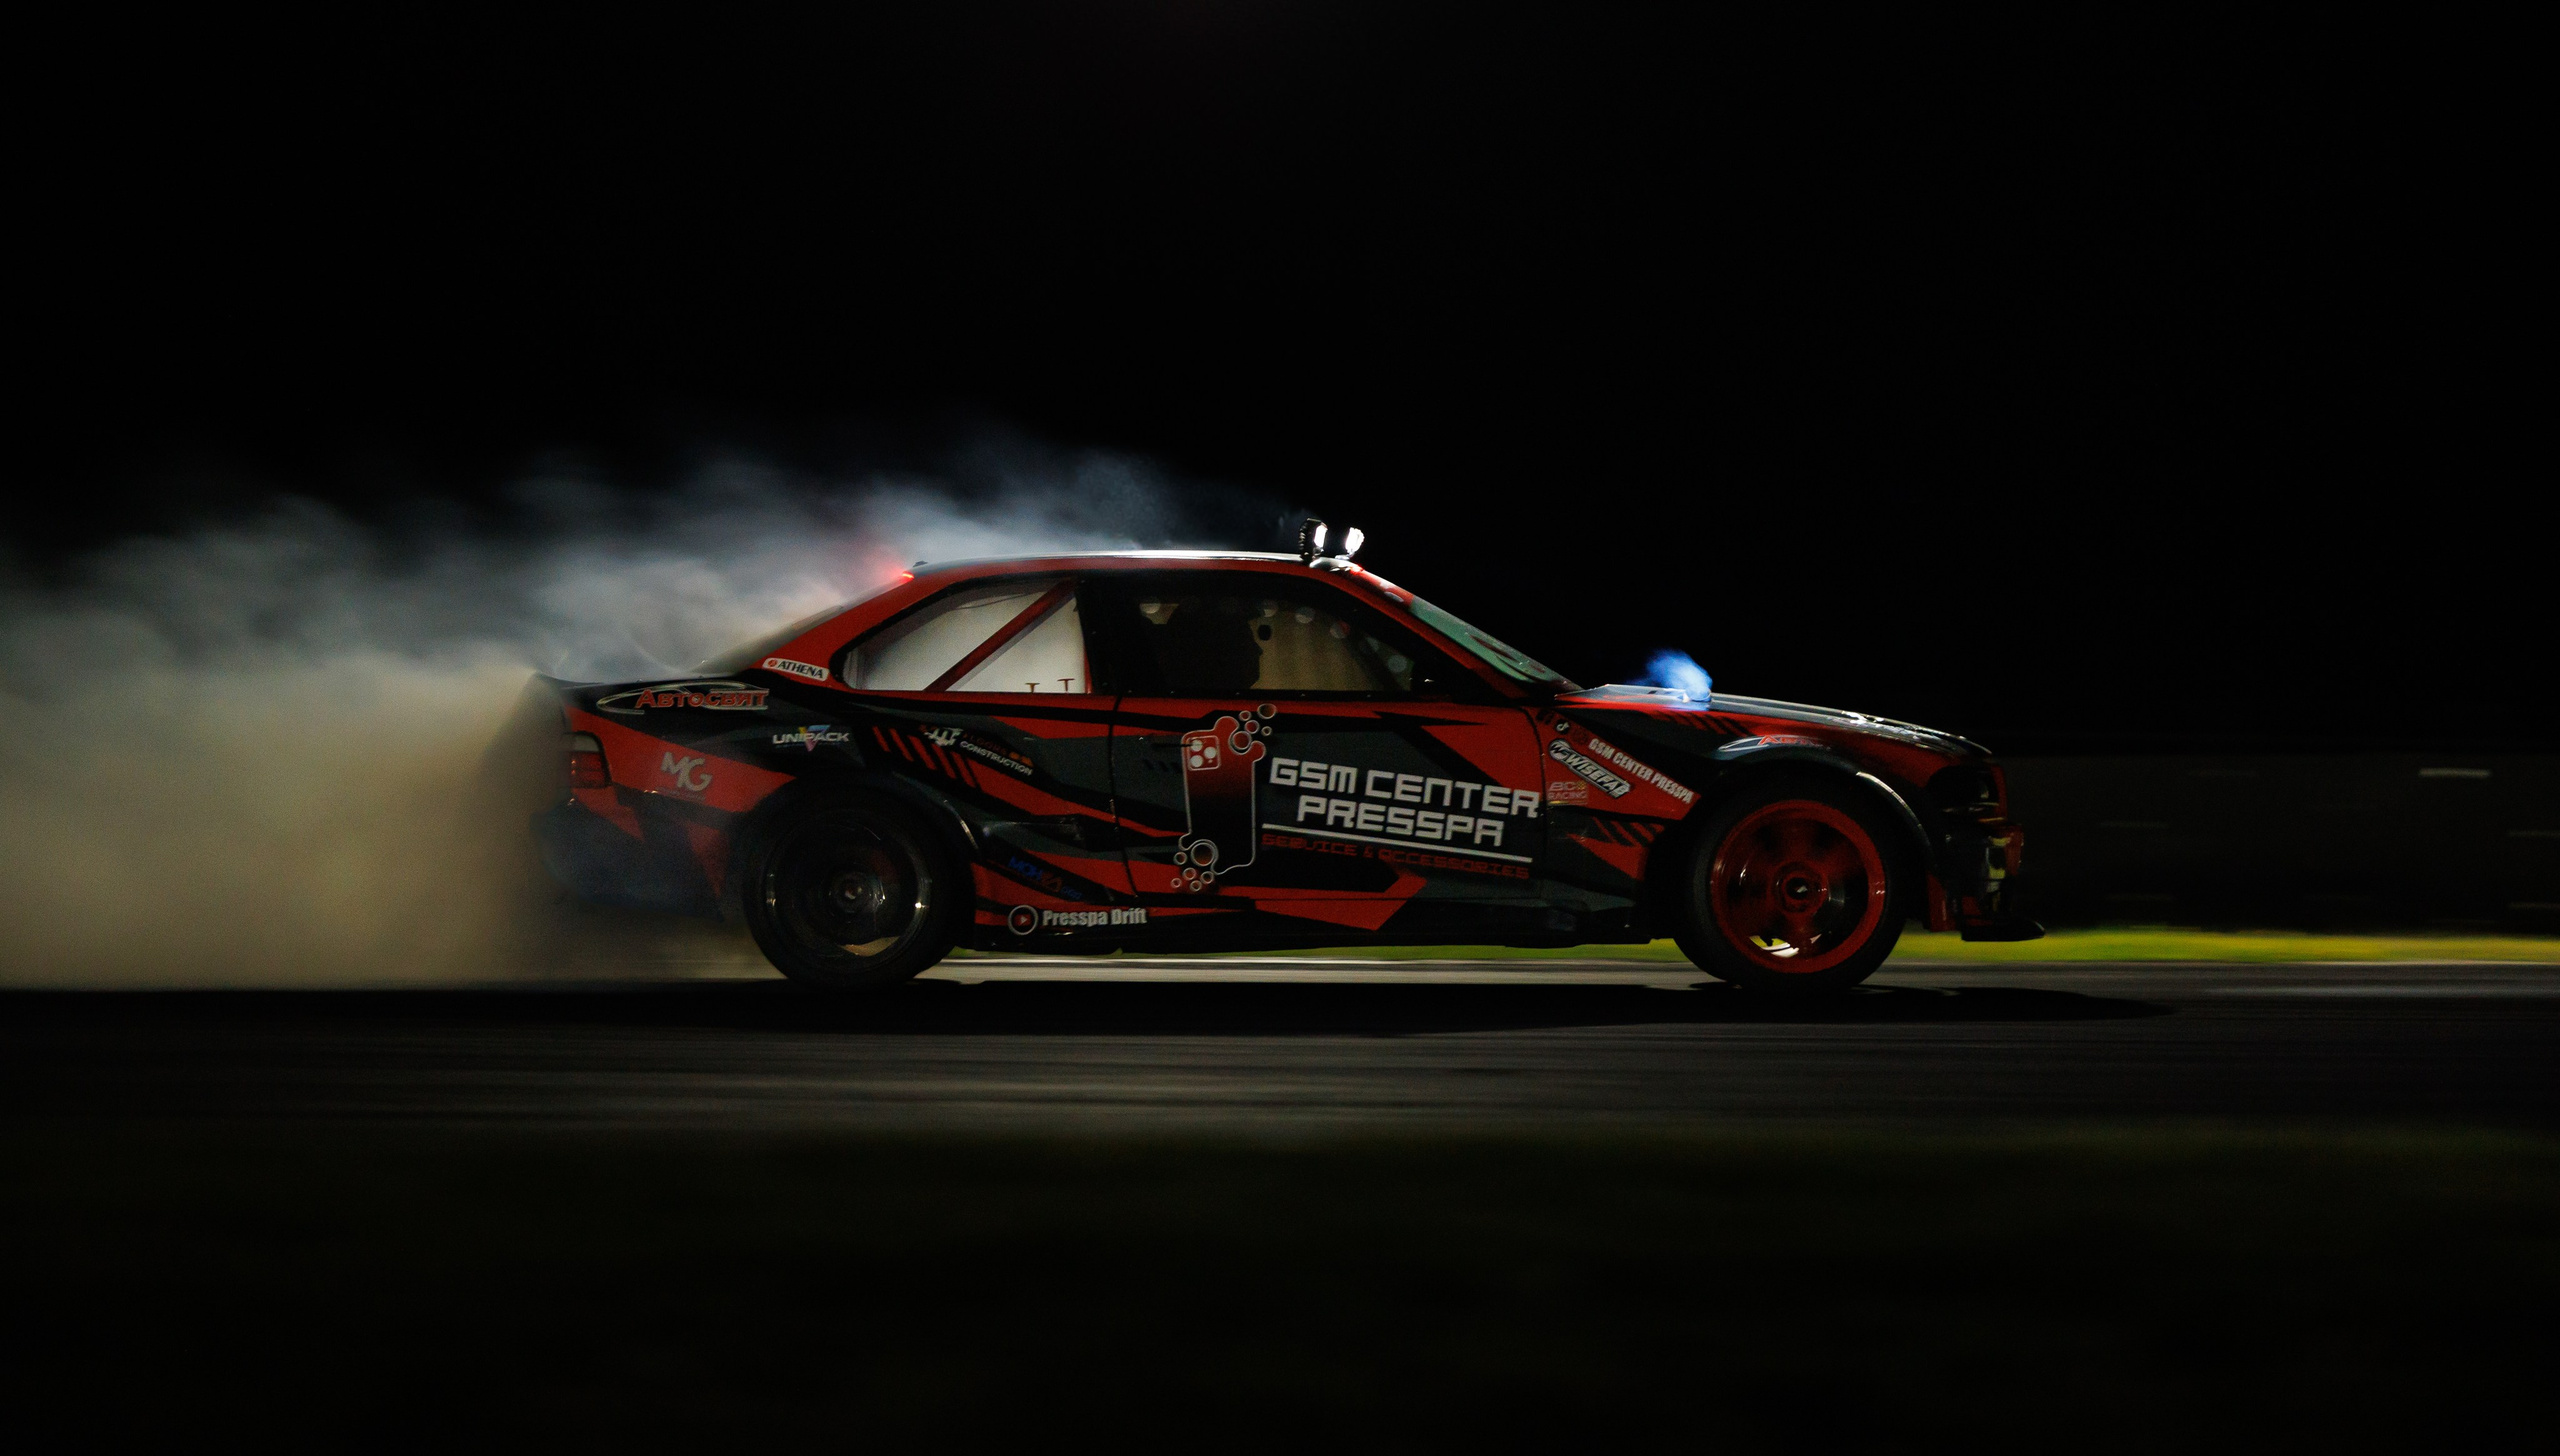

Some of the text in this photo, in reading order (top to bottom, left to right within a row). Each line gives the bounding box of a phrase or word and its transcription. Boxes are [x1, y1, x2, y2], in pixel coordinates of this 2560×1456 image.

[777, 658, 825, 681] ATHENA
[772, 731, 850, 745] UNIPACK
[959, 740, 1034, 776] CONSTRUCTION
[660, 751, 713, 792] MG
[1269, 757, 1540, 819] GSM CENTER
[1588, 738, 1695, 805] GSM CENTER PRESSPA
[1297, 794, 1505, 847] PRESSPA
[1261, 833, 1358, 857] SERVICE
[1378, 847, 1530, 879] ACCESSORIES
[1042, 908, 1147, 928] Presspa Drift
